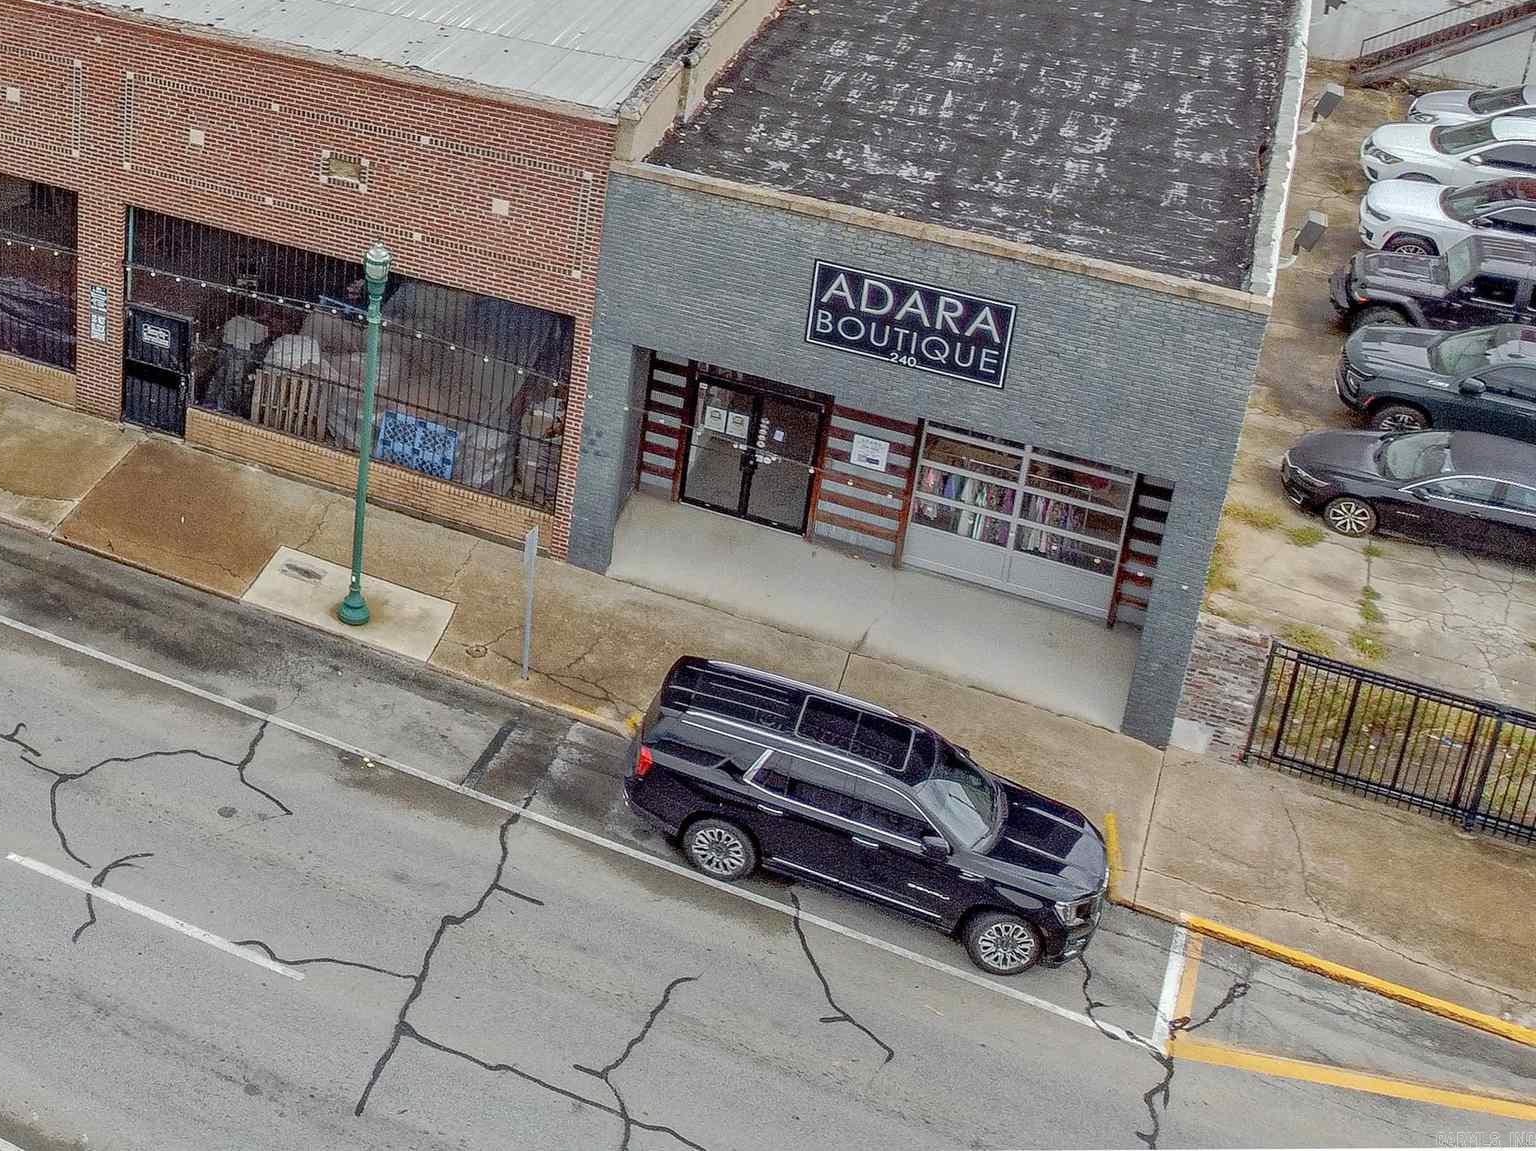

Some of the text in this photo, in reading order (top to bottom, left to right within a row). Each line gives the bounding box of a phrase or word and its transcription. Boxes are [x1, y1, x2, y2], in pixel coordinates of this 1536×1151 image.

[820, 272, 1001, 344] ADARA
[815, 309, 1000, 374] BOUTIQUE
[889, 352, 918, 368] 240
